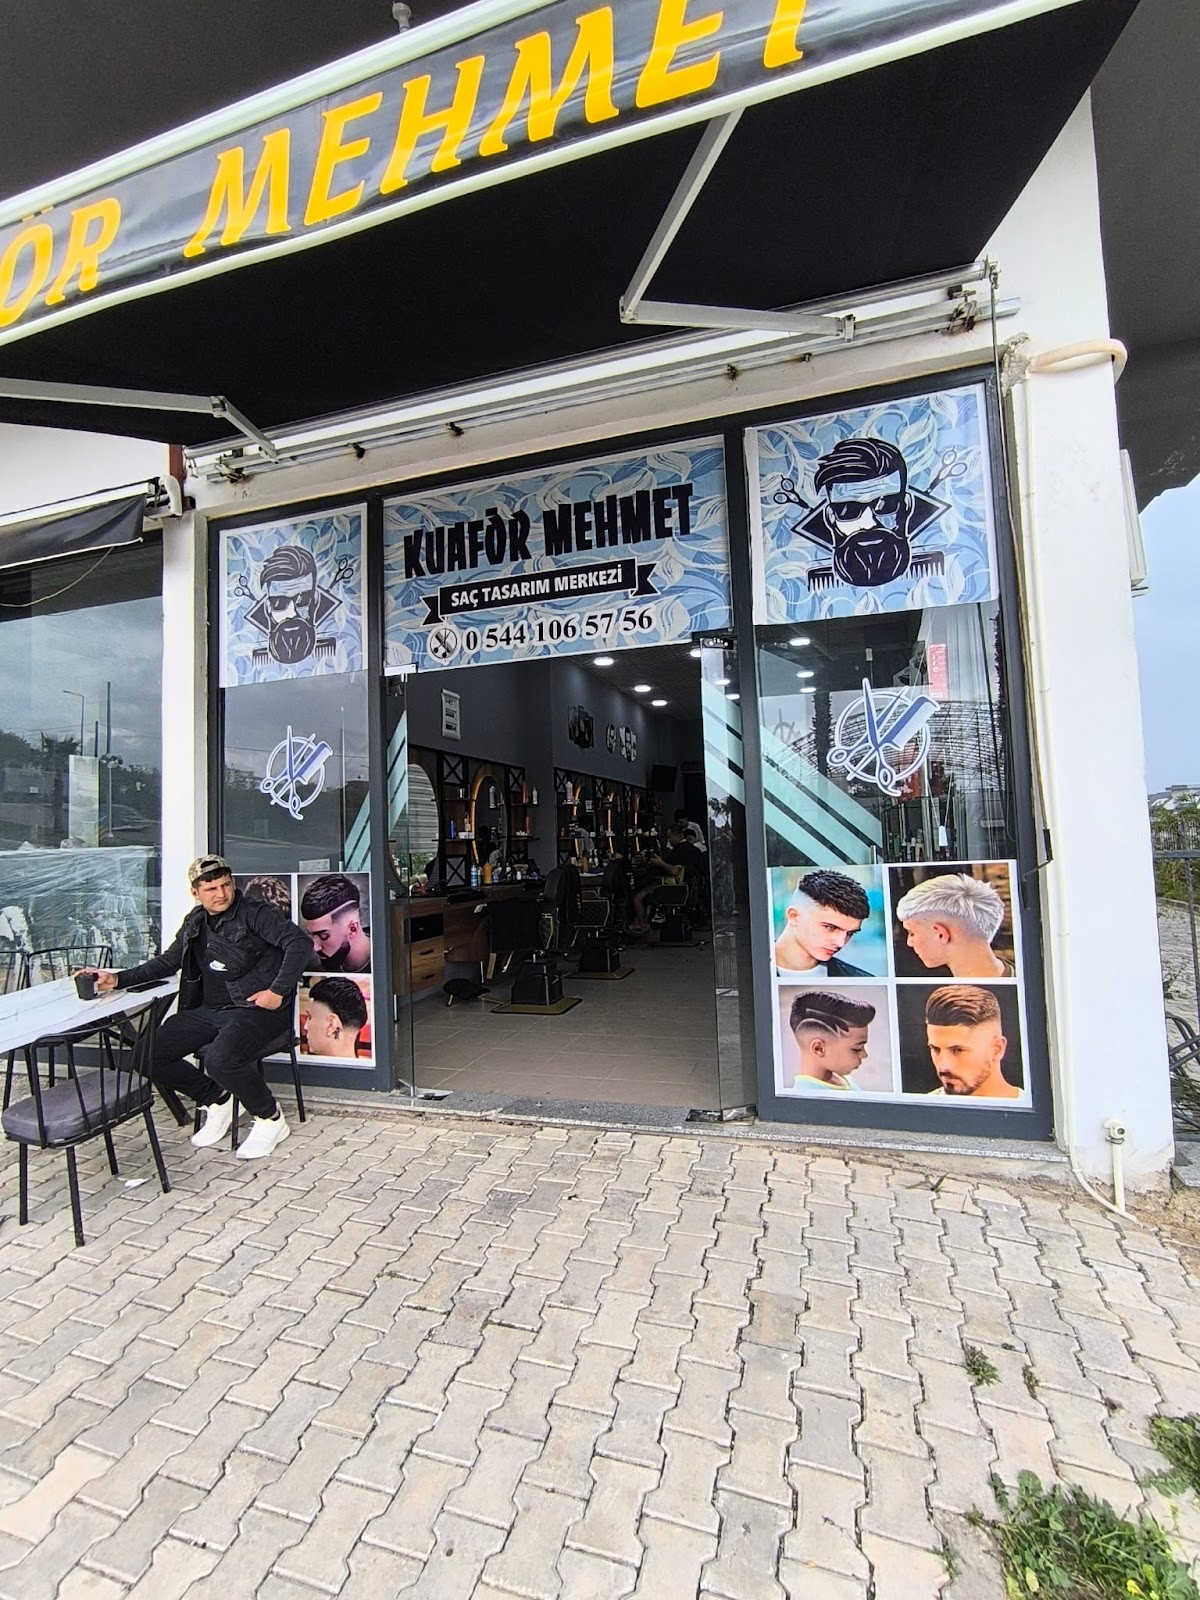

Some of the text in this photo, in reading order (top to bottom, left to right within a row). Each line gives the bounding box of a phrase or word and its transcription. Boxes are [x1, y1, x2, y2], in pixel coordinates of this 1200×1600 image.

[543, 483, 693, 556] MEHMET
[451, 565, 623, 607] SAÇ TASARIM MERKEZİ
[465, 607, 653, 651] 0 544 106 57 56
